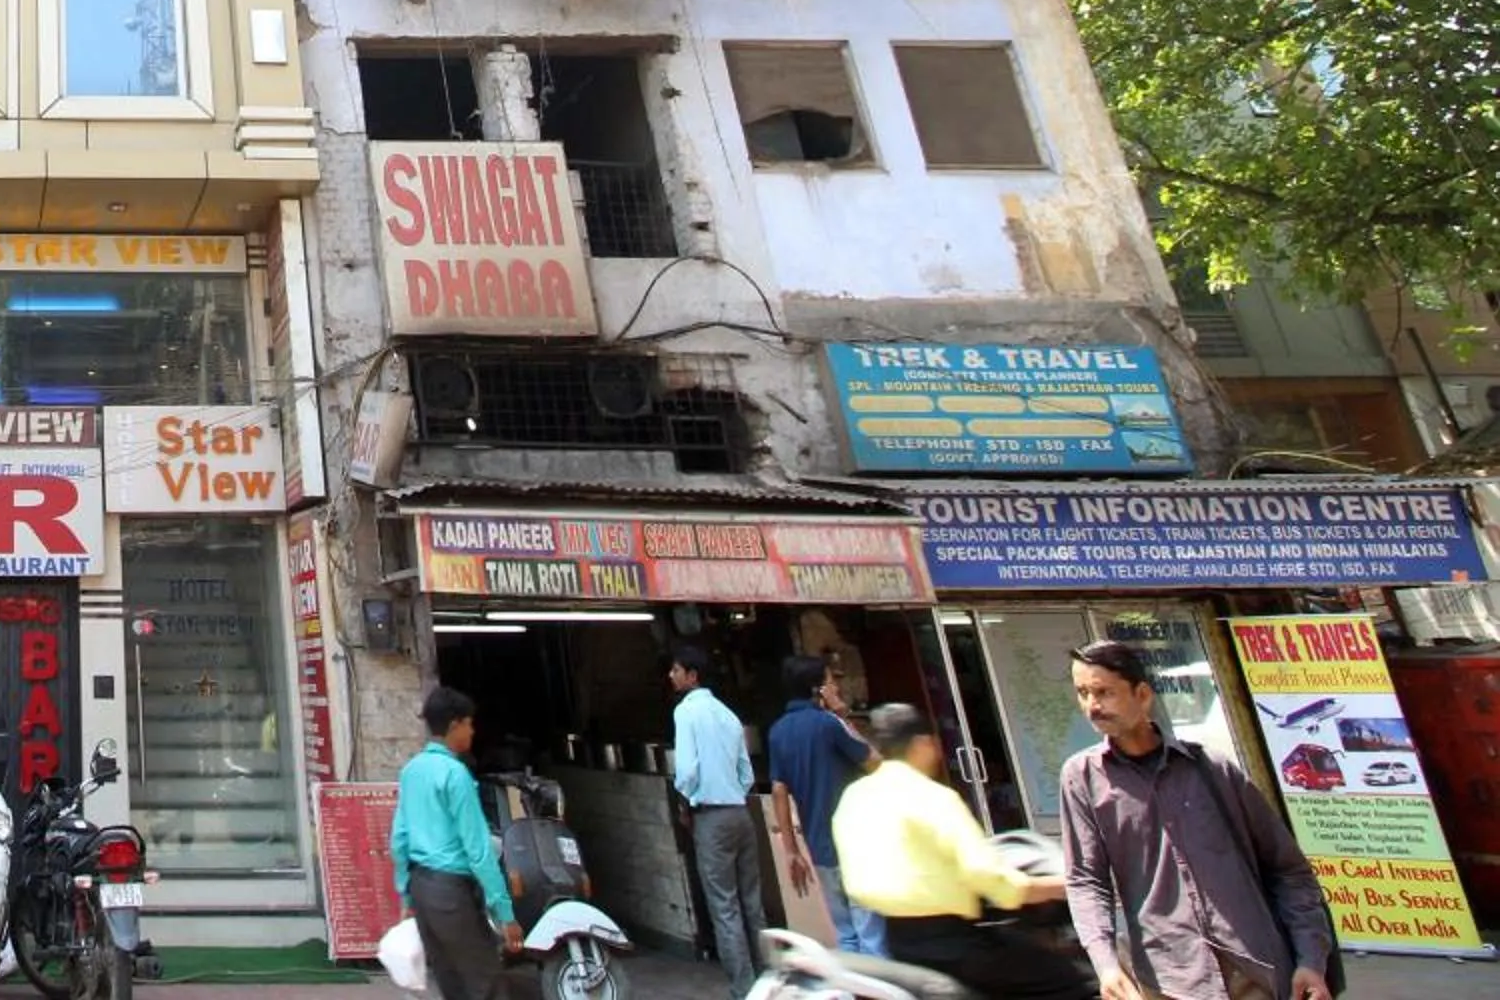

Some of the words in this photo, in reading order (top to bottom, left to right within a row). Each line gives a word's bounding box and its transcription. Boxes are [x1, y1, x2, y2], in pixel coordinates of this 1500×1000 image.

[382, 152, 567, 249] SWAGAT
[111, 237, 234, 266] VIEW
[402, 257, 578, 320] DHABA
[852, 347, 951, 368] TREK
[963, 348, 989, 368] &
[997, 348, 1138, 369] TRAVEL
[157, 415, 264, 456] Star
[873, 438, 975, 450] TELEPHONE
[986, 439, 1019, 451] STD
[1081, 440, 1113, 450] FAX
[156, 461, 277, 503] View
[911, 498, 1057, 523] TOURIST
[1070, 496, 1312, 523] INFORMATION
[1319, 496, 1455, 521] CENTRE
[431, 519, 484, 548] KADAI
[487, 522, 556, 551] PANEER
[921, 527, 1009, 542] ESERVATION
[1012, 527, 1042, 541] FOR
[1045, 527, 1096, 542] FLIGHT
[1099, 527, 1161, 543] TICKETS,
[1165, 527, 1205, 541] TRAIN
[1209, 526, 1271, 541] TICKETS,
[1273, 526, 1301, 540] BUS
[1304, 526, 1361, 540] TICKETS
[1364, 526, 1374, 539] &
[1377, 526, 1405, 540] CAR
[1408, 525, 1460, 539] RENTAL
[936, 547, 1003, 561] SPECIAL
[1008, 547, 1079, 561] PACKAGE
[1083, 546, 1137, 560] TOURS
[1140, 546, 1172, 560] FOR
[1175, 545, 1267, 560] RAJASTHAN
[1270, 544, 1304, 558] AND
[1306, 544, 1360, 558] INDIAN
[1362, 543, 1449, 557] HIMALAYAS
[485, 560, 536, 595] TAWA
[538, 561, 580, 595] ROTI
[590, 565, 641, 598] THALI
[998, 565, 1107, 579] INTERNATIONAL
[1109, 564, 1192, 578] TELEPHONE
[1193, 563, 1267, 577] AVAILABLE
[1268, 563, 1306, 577] HERE
[1308, 563, 1341, 578] STD,
[1371, 563, 1398, 576] FAX
[1235, 625, 1287, 662] TREK
[1283, 625, 1300, 662] &
[1297, 621, 1379, 662] TRAVELS
[20, 629, 63, 794] BAR
